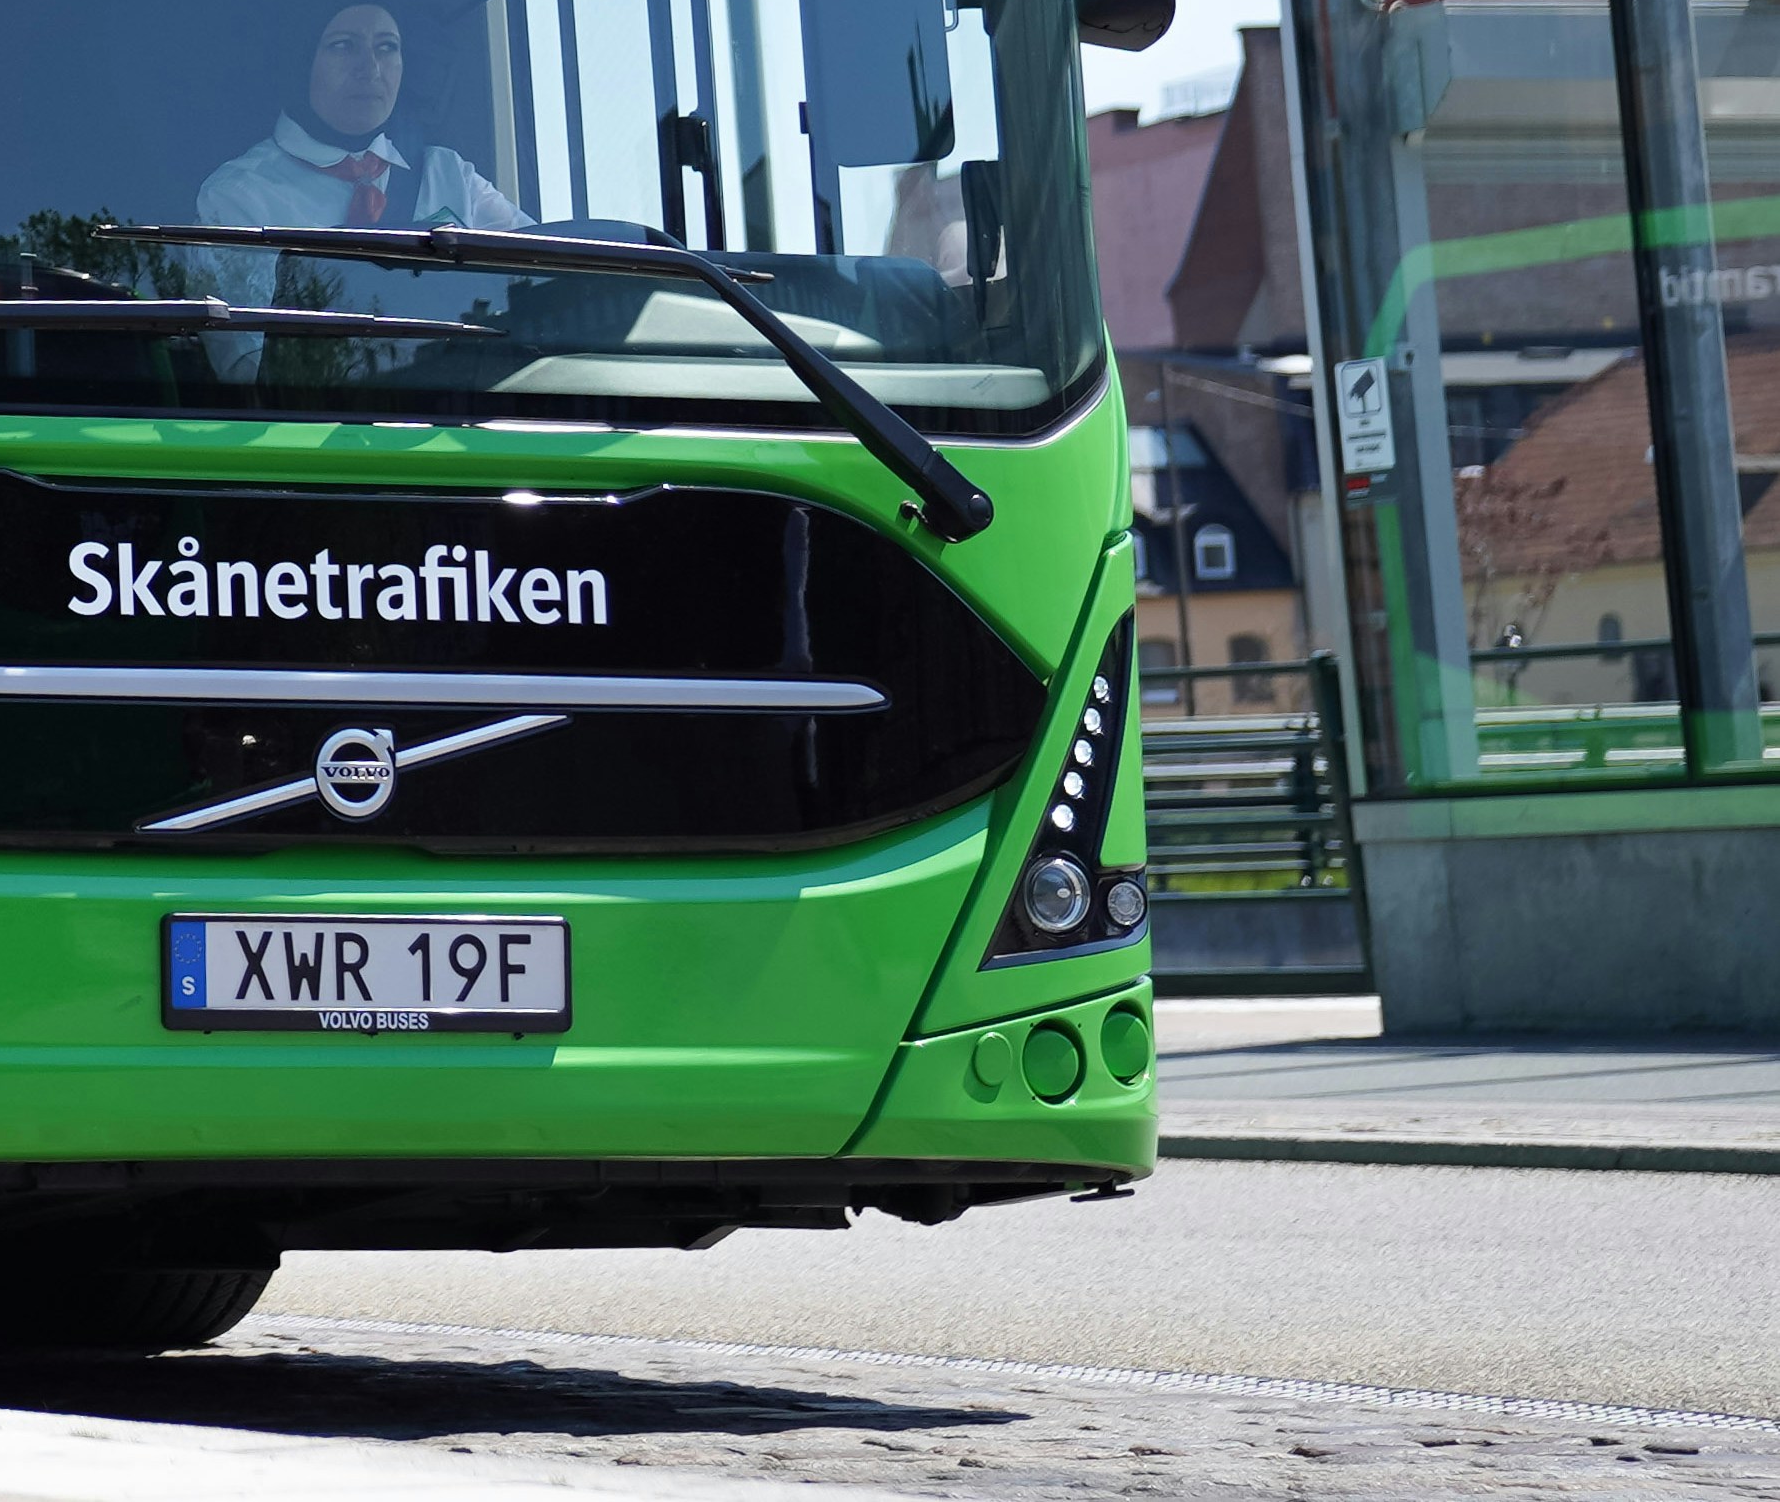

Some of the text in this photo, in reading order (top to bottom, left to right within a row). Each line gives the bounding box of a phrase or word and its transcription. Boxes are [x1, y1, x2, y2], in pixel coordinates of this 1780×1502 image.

[67, 536, 610, 626] Skånetrafiken
[321, 766, 390, 779] VOLVO
[181, 930, 532, 1003] S XWR 19F
[319, 1012, 429, 1030] VOLVO BUSES
